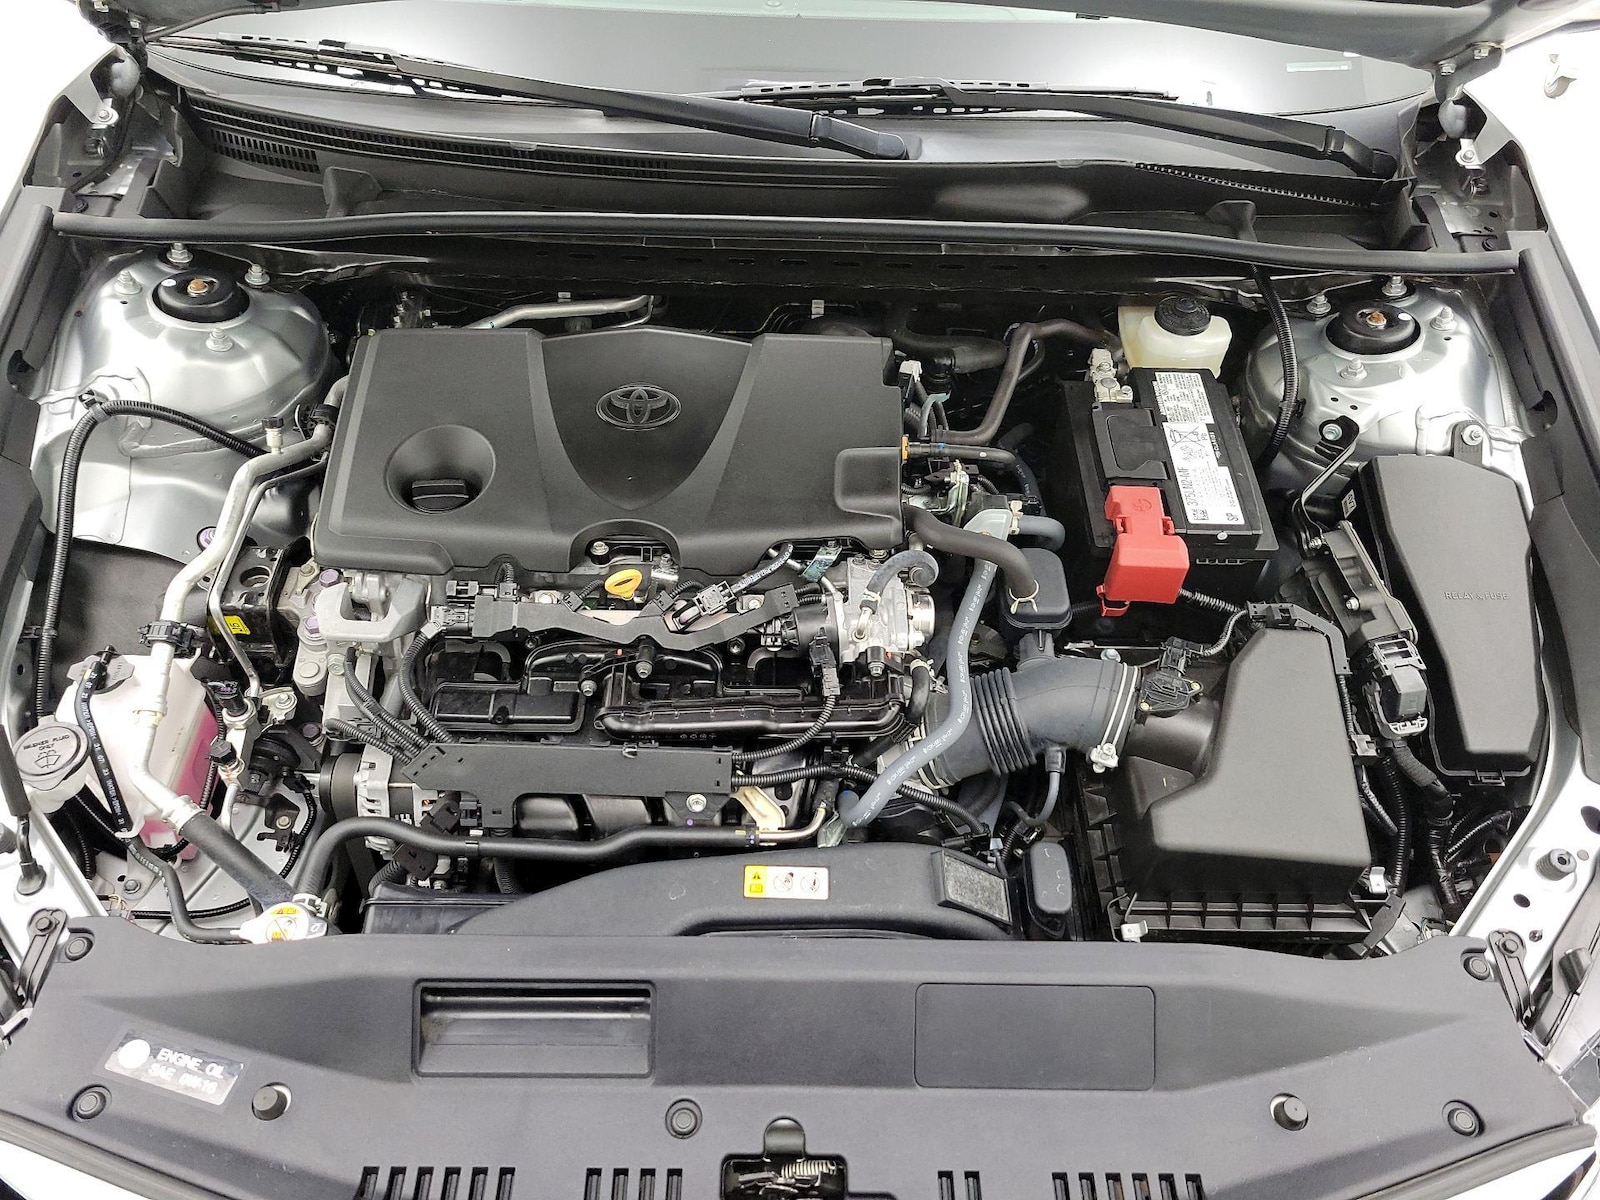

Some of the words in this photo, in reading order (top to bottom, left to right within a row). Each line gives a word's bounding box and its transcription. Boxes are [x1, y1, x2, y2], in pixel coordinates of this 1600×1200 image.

[1444, 591, 1474, 600] RELAY
[148, 1062, 177, 1081] SAE
[157, 1047, 204, 1072] ENGINE
[205, 1062, 225, 1080] OIL
